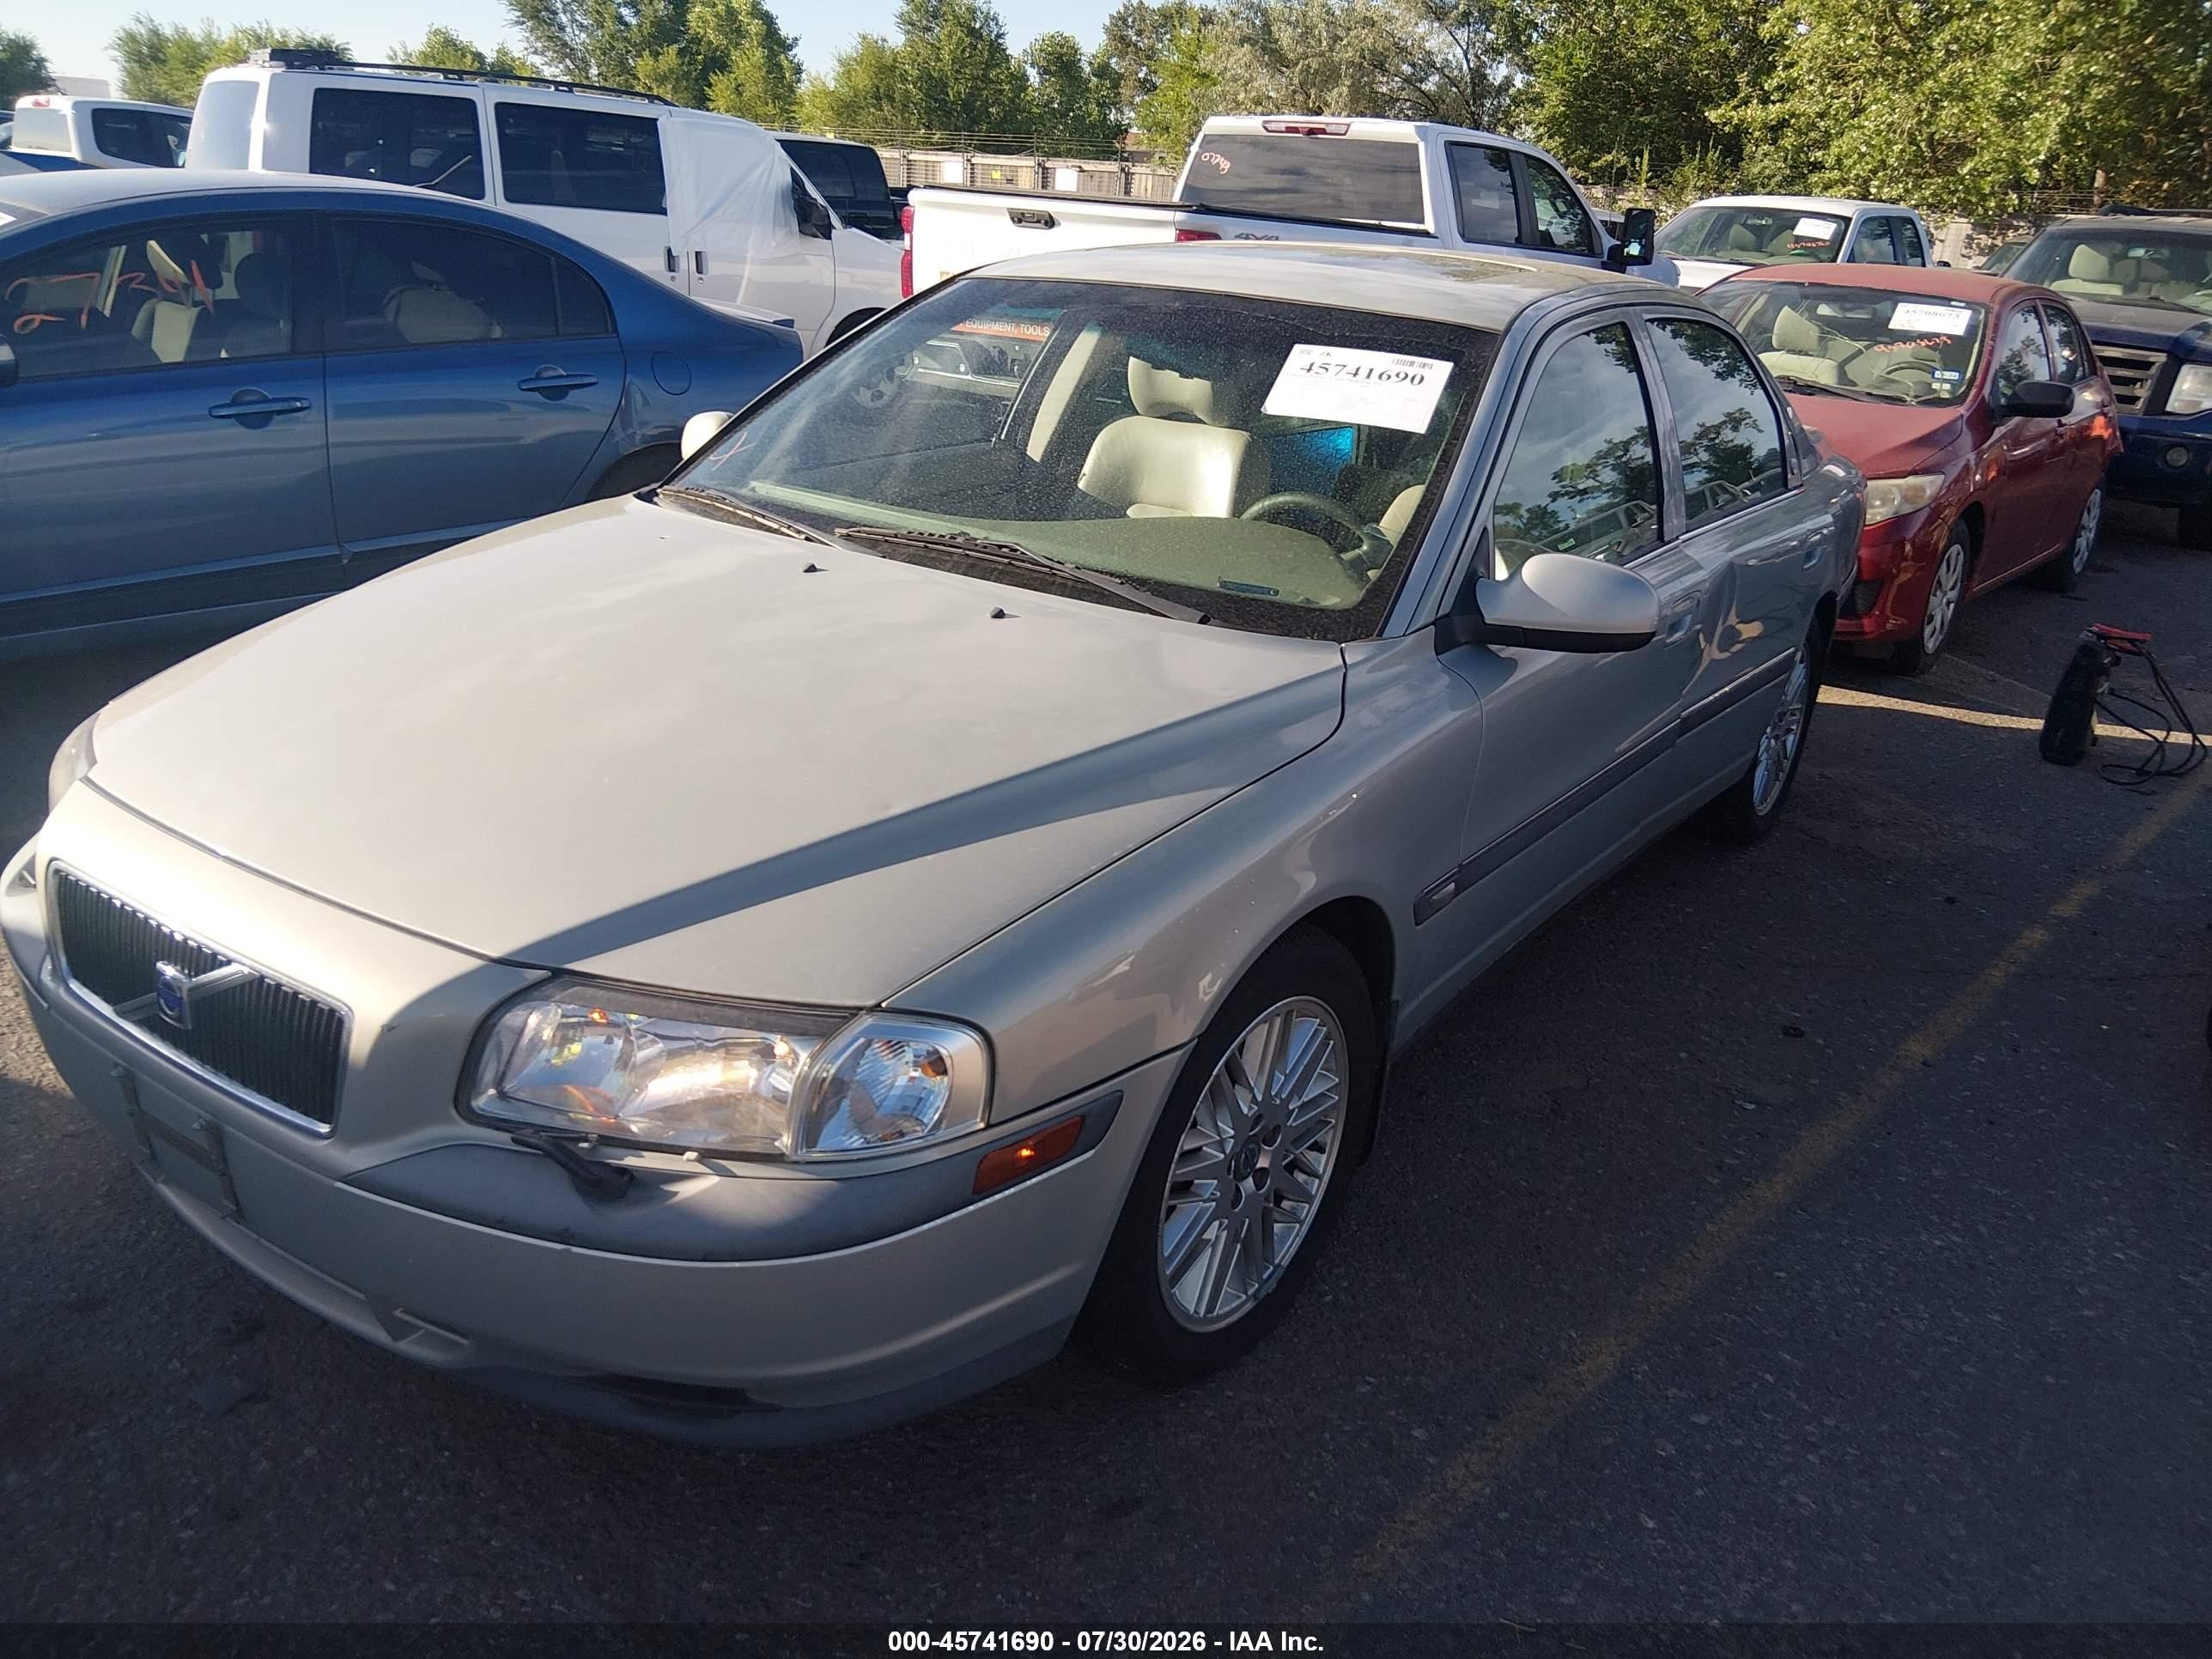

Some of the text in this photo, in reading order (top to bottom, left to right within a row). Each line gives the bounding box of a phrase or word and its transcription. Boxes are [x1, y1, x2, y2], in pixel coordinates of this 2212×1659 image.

[966, 319, 1018, 333] EQUIPMENT,
[1019, 325, 1049, 337] TOOLS
[1300, 361, 1425, 386] 45741690
